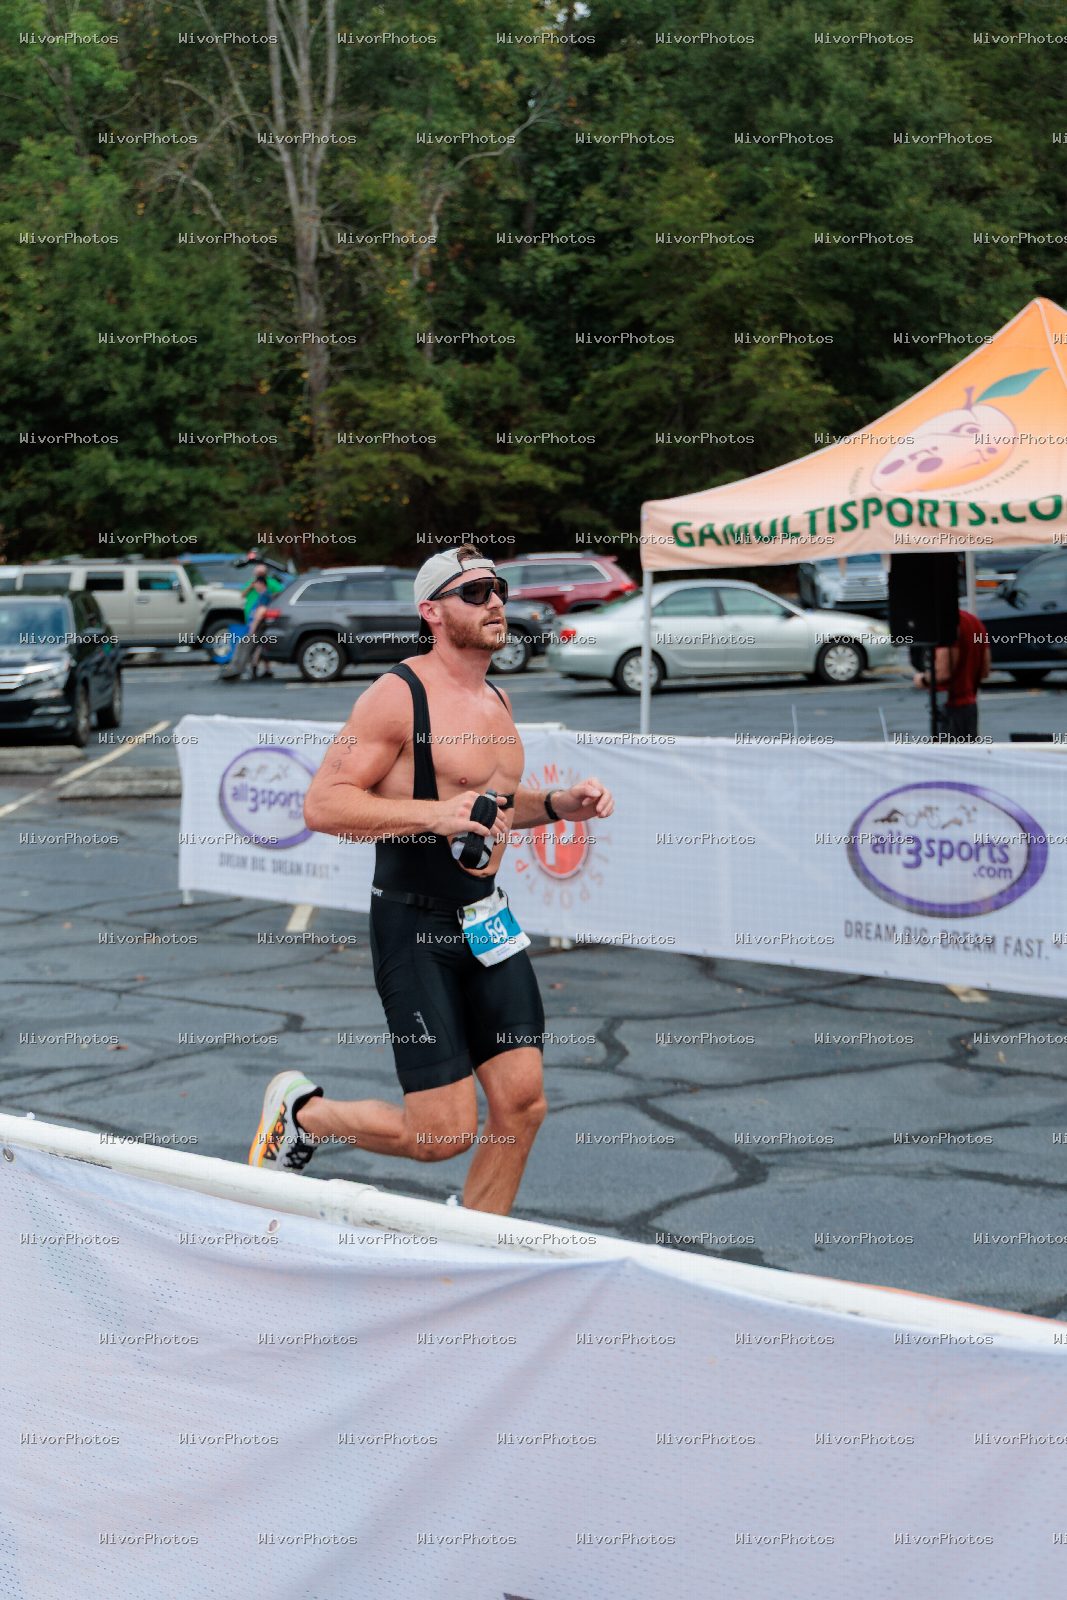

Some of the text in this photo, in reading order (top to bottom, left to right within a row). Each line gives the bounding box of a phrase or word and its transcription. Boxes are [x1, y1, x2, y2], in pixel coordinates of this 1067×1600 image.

[871, 828, 1010, 869] all3sports
[973, 863, 1014, 880] .com
[484, 916, 509, 944] 59
[844, 919, 898, 942] DREAM
